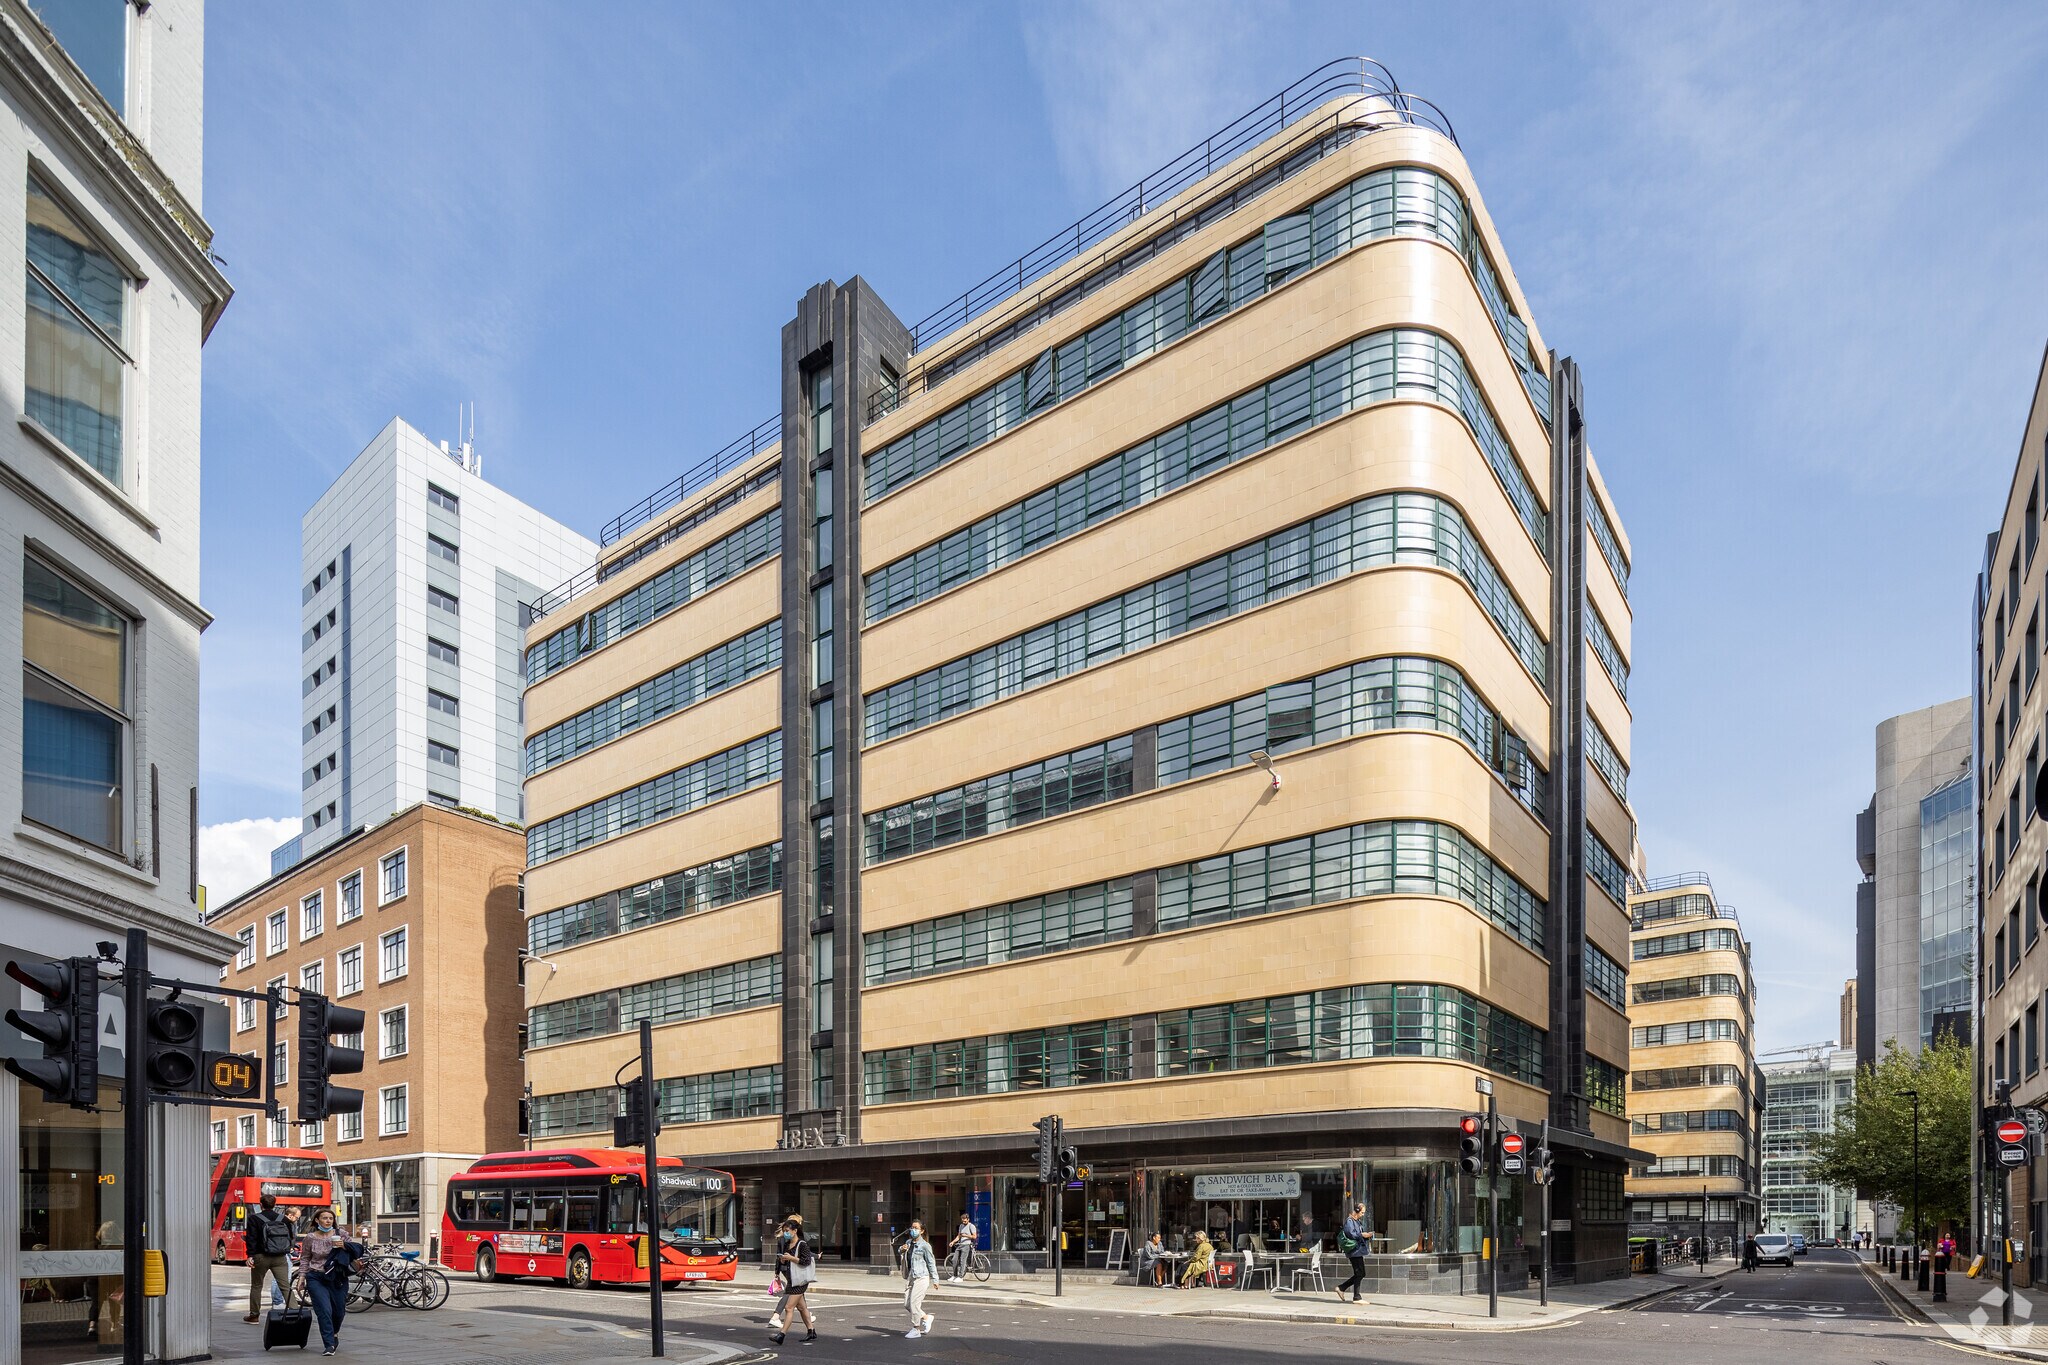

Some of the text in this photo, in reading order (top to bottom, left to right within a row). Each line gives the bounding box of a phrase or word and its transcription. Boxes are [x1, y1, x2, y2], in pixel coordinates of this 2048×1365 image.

[214, 1062, 250, 1089] 04
[784, 1127, 825, 1150] IBEX
[1077, 1167, 1089, 1178] 04
[661, 1175, 721, 1190] Shadwell 100
[1207, 1174, 1284, 1185] SANDWICH BAR
[265, 1184, 295, 1192] Nunhead
